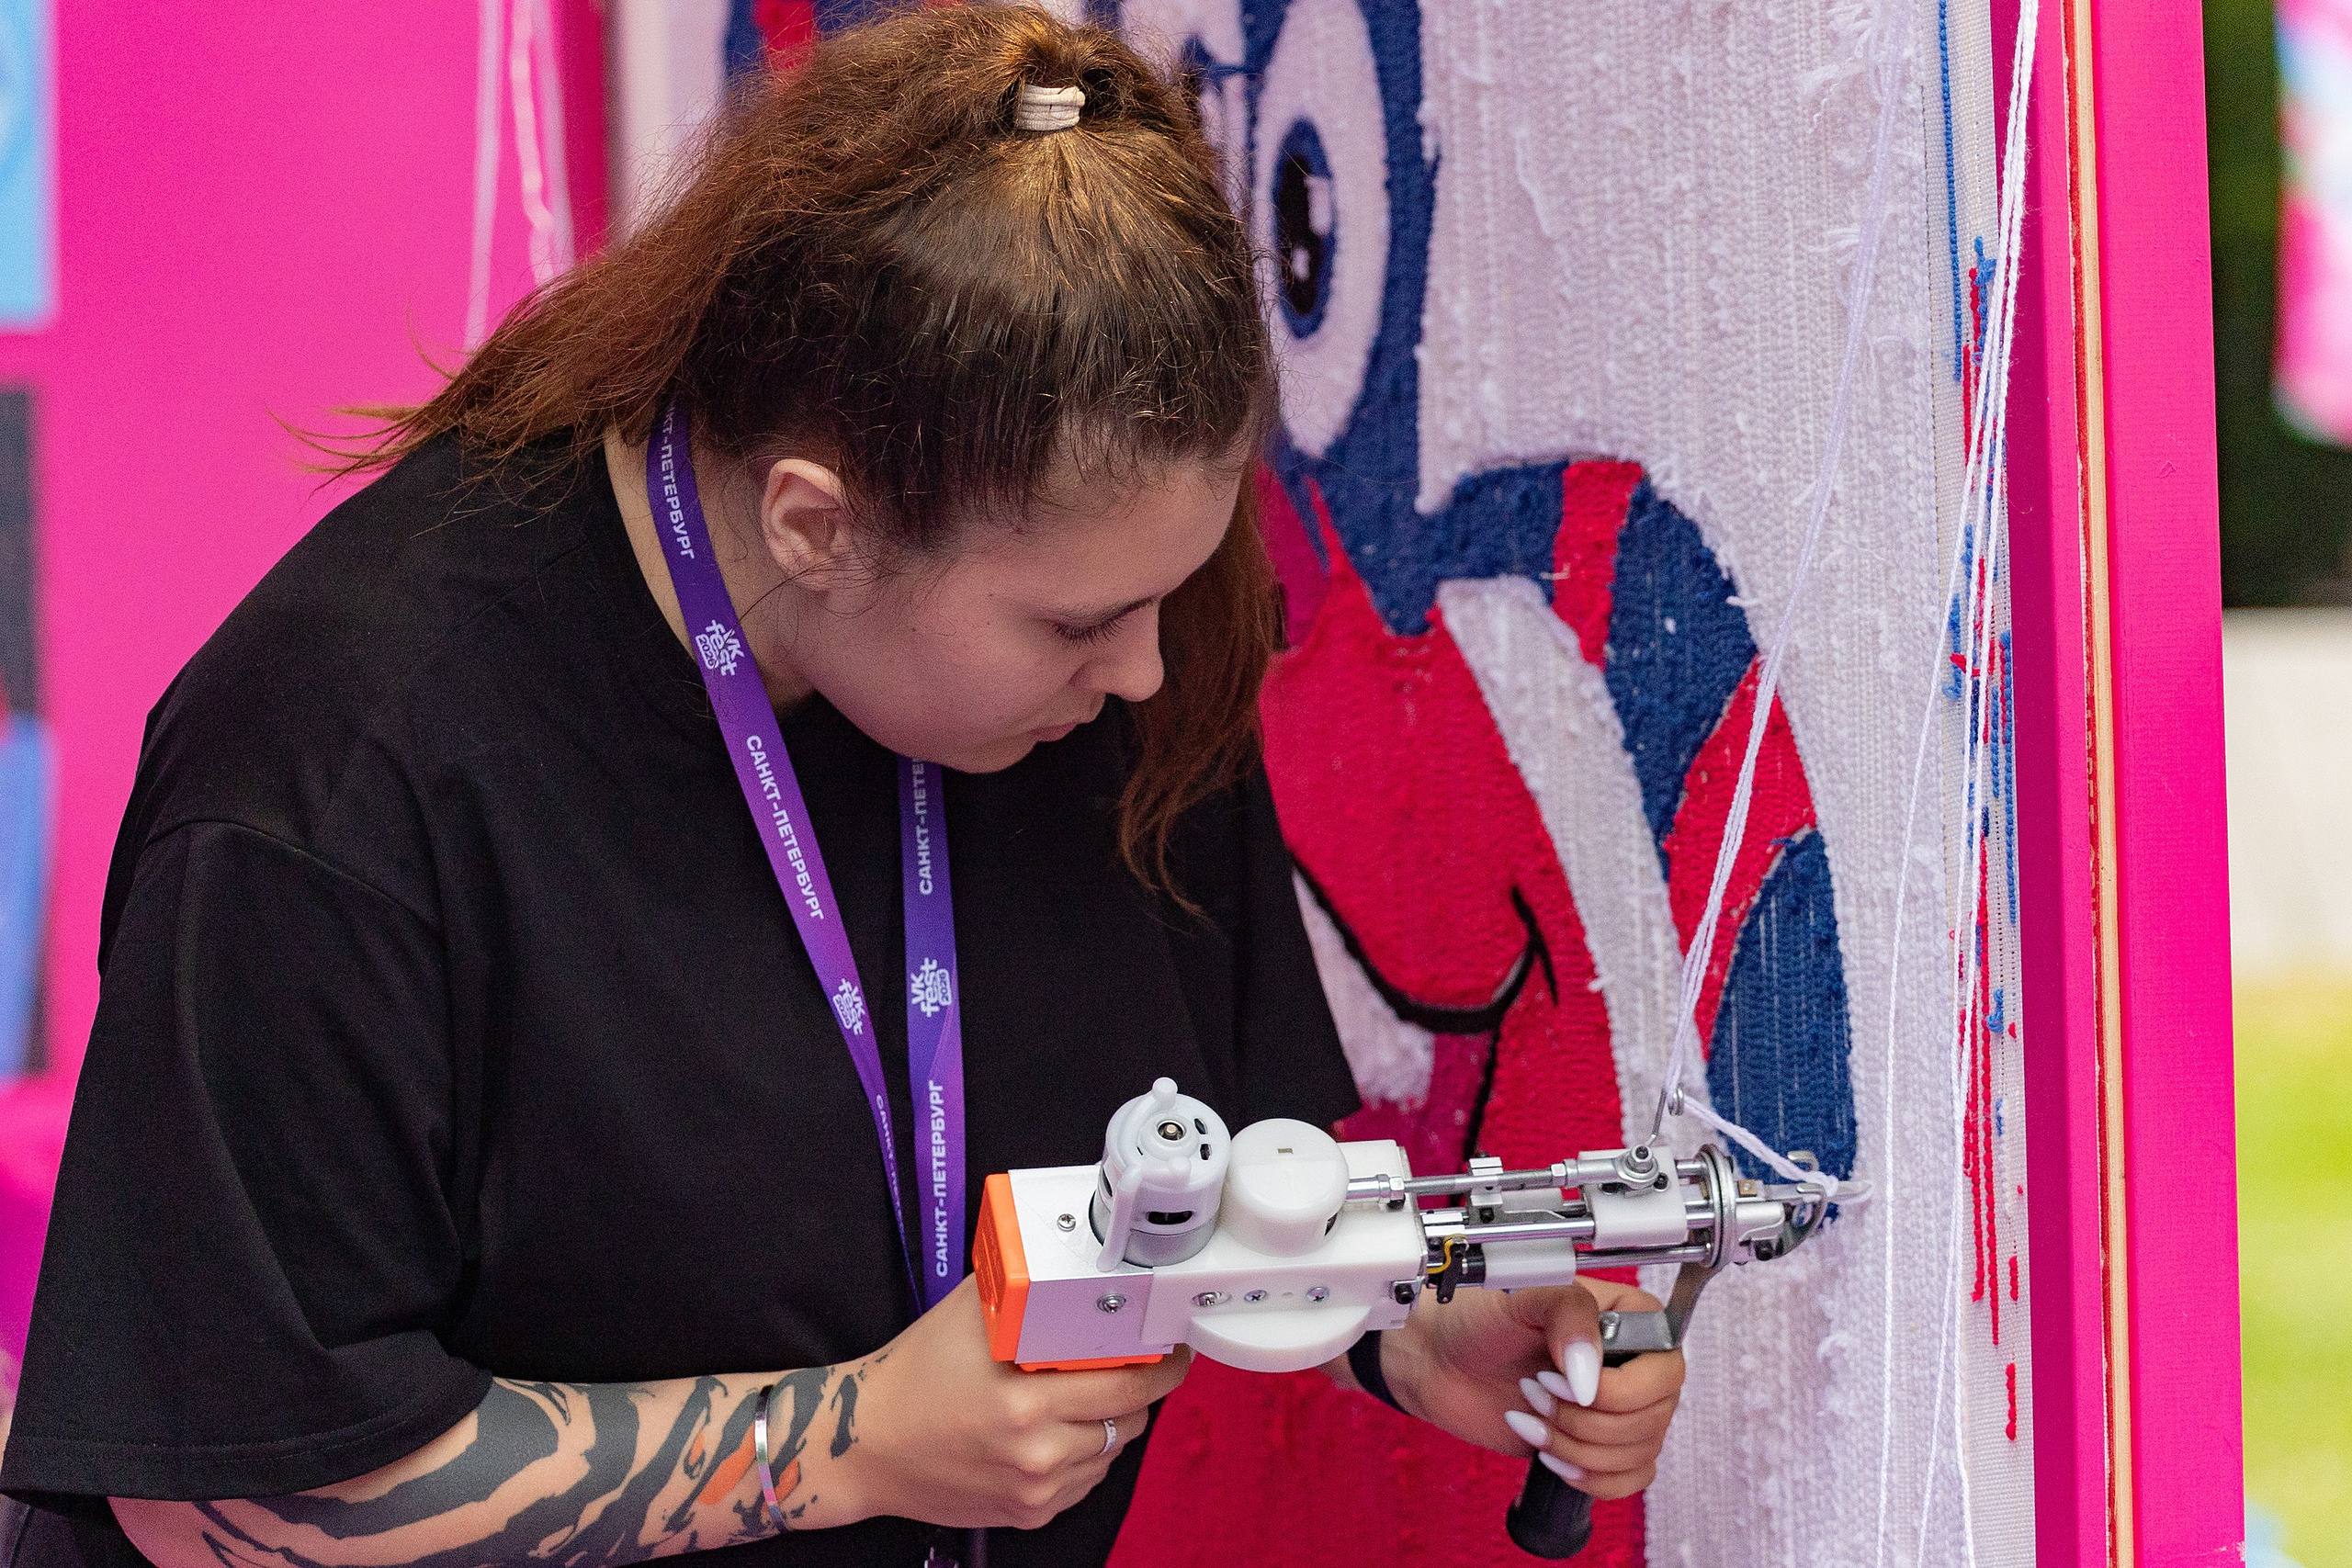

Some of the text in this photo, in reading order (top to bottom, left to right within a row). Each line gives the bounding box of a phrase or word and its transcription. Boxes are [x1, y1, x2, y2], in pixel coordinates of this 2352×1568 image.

[706, 619, 738, 676] fest
[723, 628, 745, 660] VK
[746, 735, 825, 920] САНКТ-ПЕТЕРБУРГ
[912, 757, 933, 896] САНКТ-ПЕТЕ
[838, 977, 864, 1035] fest
[852, 986, 865, 1018] VK
[910, 972, 924, 1005] VK
[920, 956, 940, 1017] fest
[928, 1080, 948, 1278] САНКТ-ПЕТЕРБУРГ
